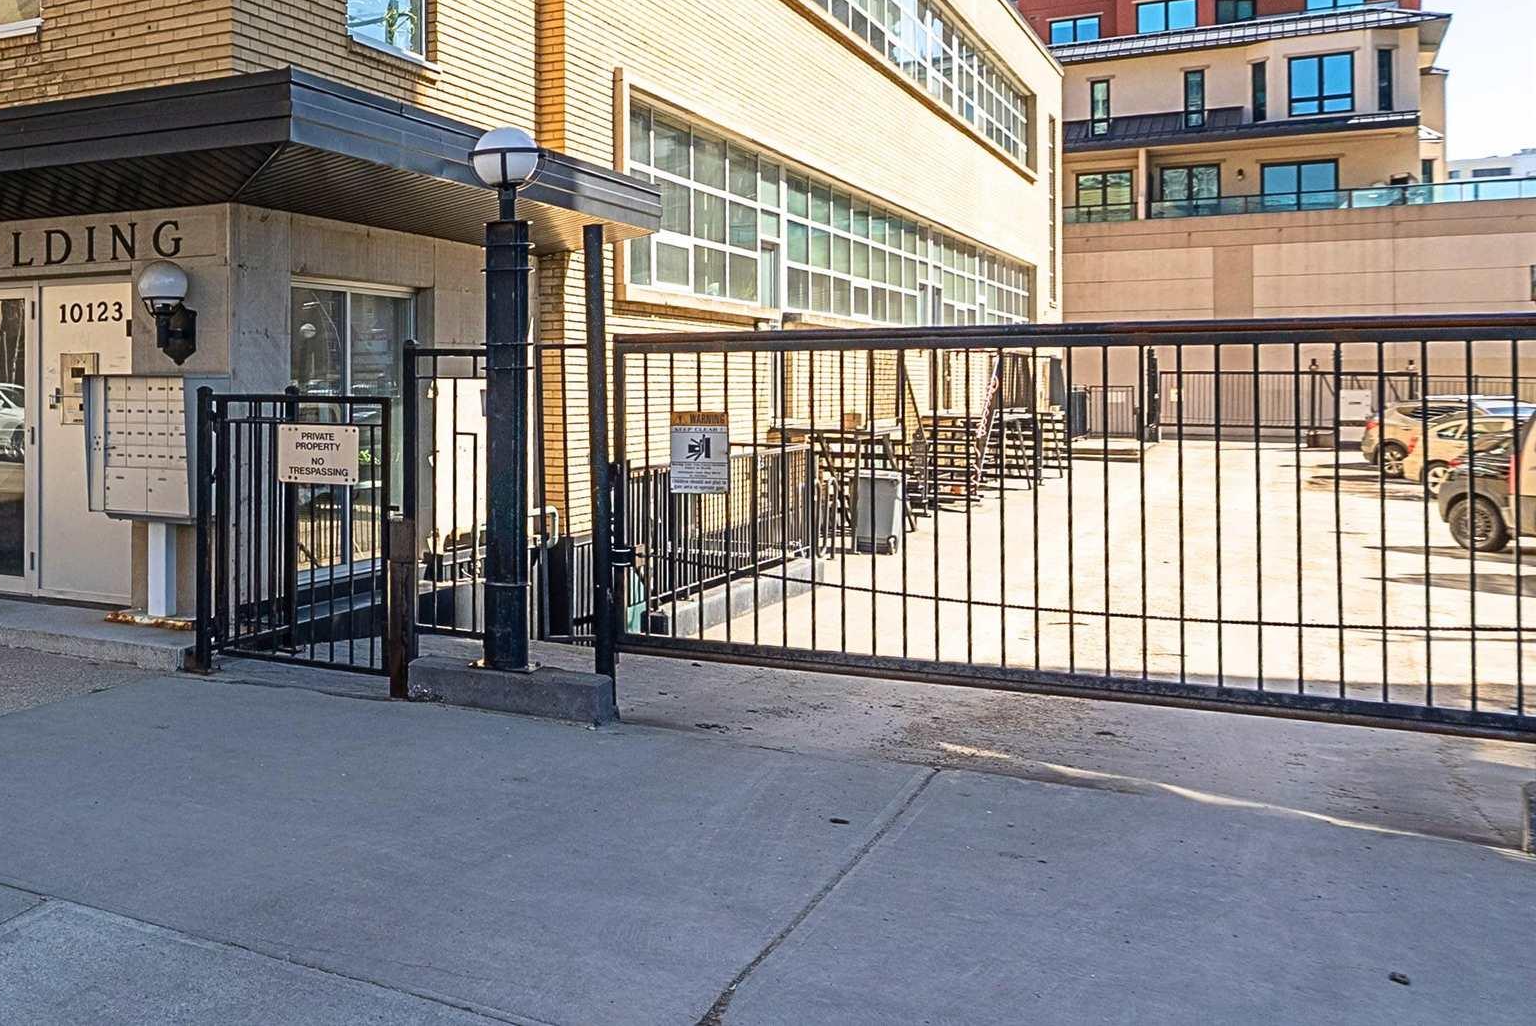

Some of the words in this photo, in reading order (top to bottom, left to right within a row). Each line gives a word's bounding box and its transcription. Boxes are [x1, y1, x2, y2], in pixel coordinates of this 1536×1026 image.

[59, 301, 123, 323] 10123
[689, 414, 725, 424] WARNING
[301, 432, 335, 441] PRIVATE
[295, 442, 341, 451] PROPERTY
[311, 457, 325, 466] NO
[289, 466, 349, 476] TRESPASSING
